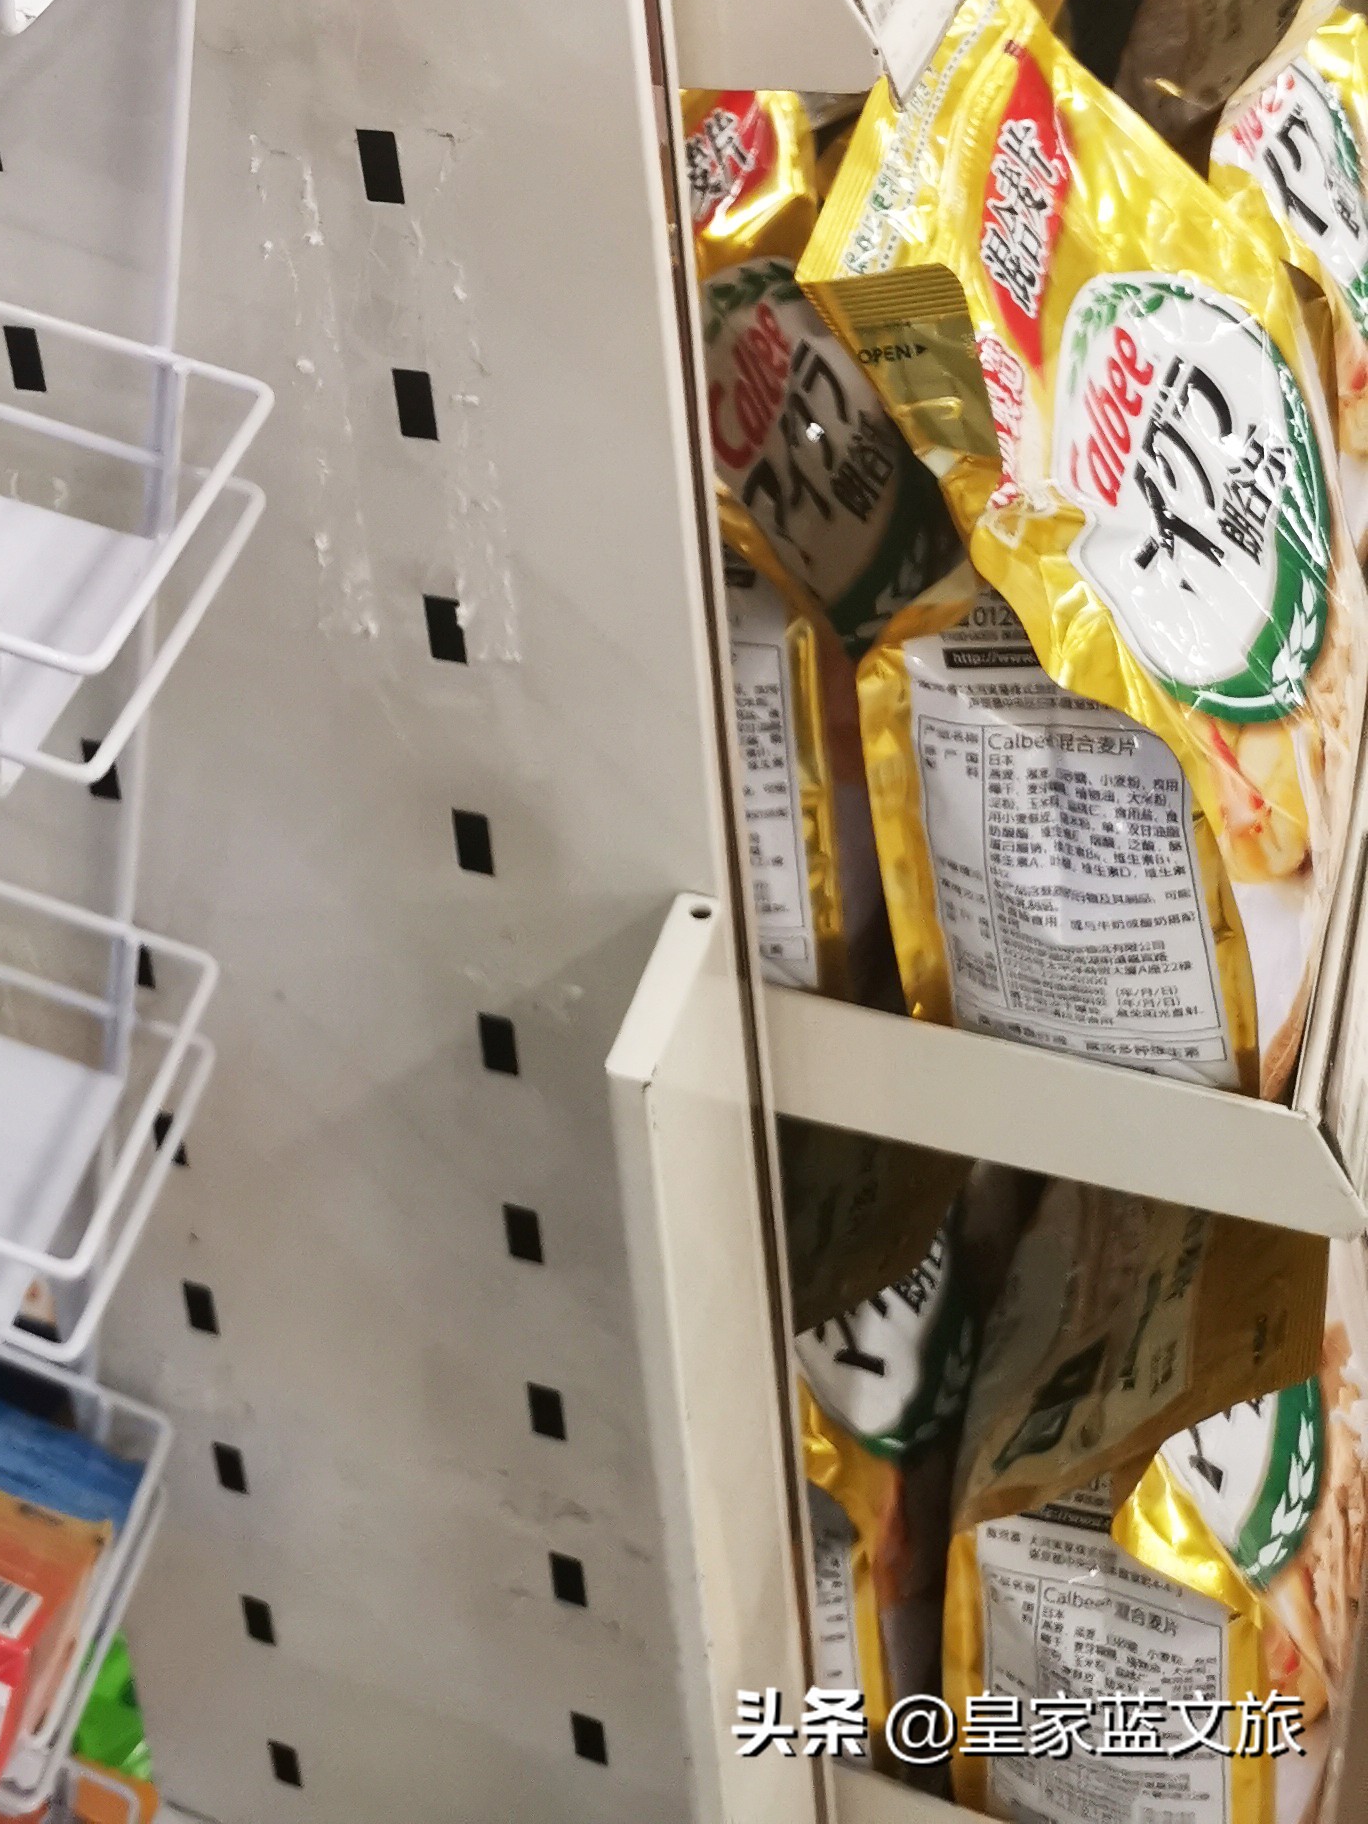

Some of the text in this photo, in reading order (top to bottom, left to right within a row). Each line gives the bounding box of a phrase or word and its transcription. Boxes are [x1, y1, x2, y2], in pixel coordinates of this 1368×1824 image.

[985, 121, 1055, 314] 混合麦片
[857, 343, 914, 367] OPEN
